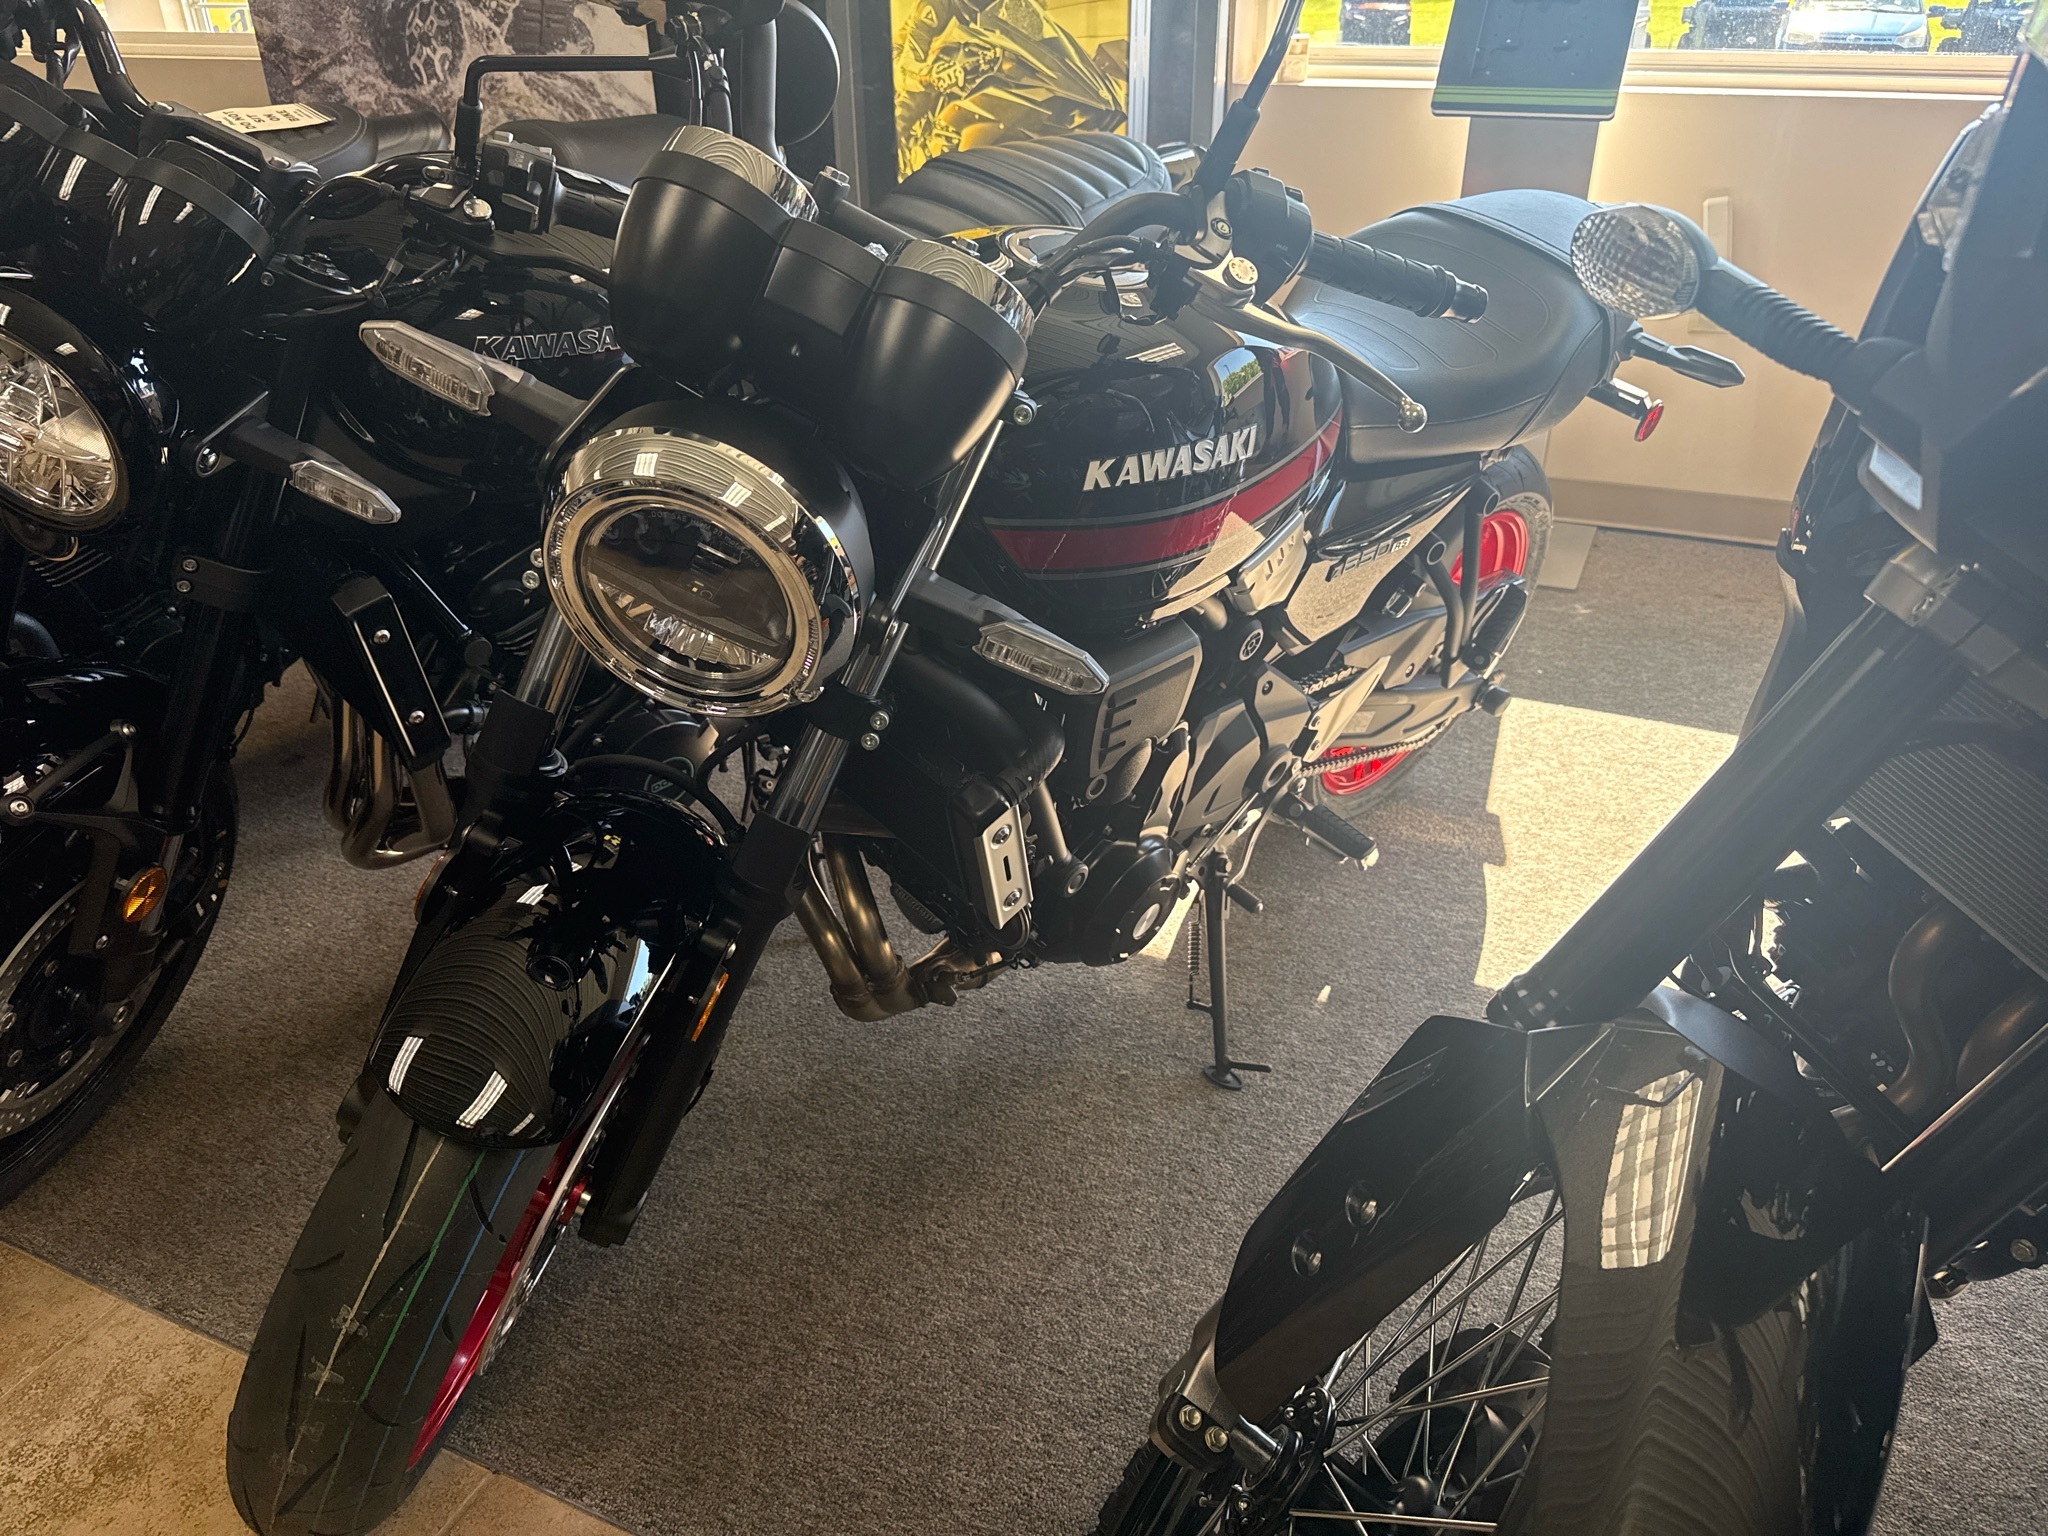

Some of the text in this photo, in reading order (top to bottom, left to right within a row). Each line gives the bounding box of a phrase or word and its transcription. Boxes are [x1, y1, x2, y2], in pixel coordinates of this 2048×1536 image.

[222, 110, 245, 122] NOT
[246, 113, 266, 123] SIT
[264, 113, 281, 122] ON
[276, 109, 299, 122] BIKE
[239, 121, 257, 130] DO
[474, 325, 621, 361] KAWASA
[1082, 423, 1258, 492] KAWASAKI
[650, 510, 668, 519] DOT
[671, 512, 688, 521] SAE
